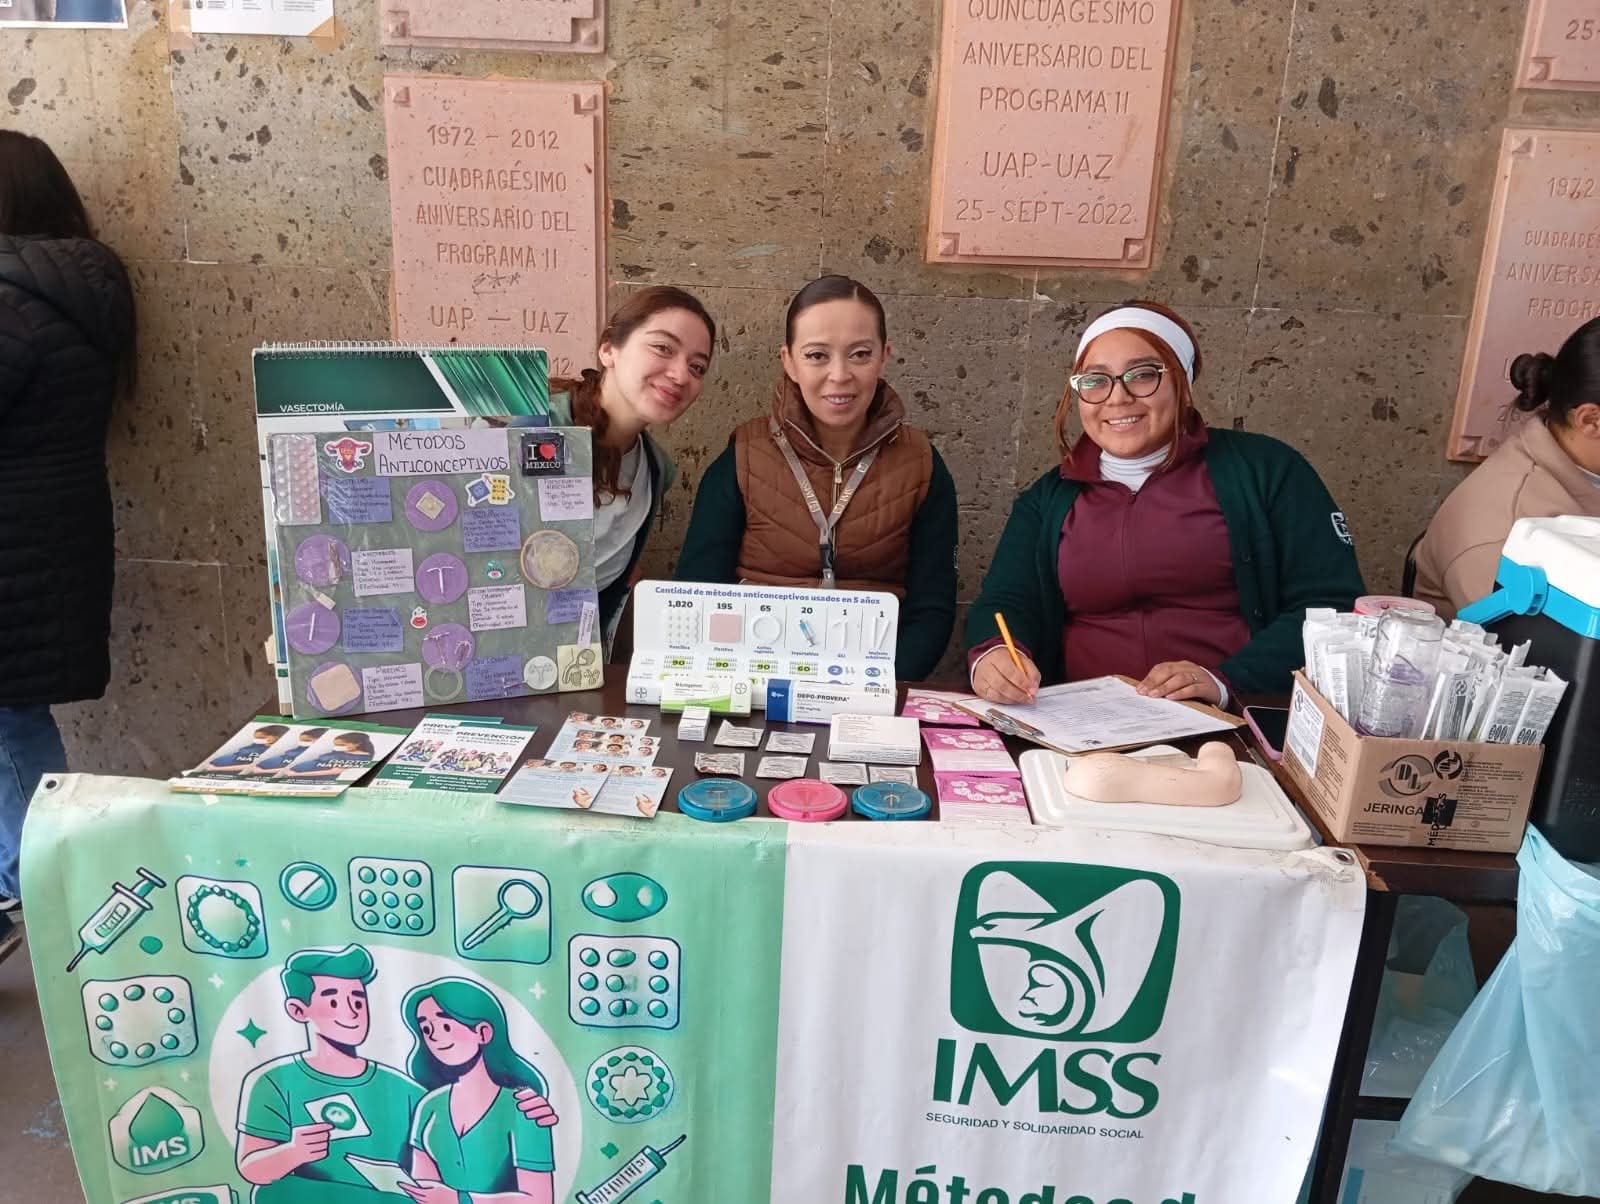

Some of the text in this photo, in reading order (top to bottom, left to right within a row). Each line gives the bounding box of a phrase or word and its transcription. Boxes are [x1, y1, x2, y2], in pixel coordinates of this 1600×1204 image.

[963, 41, 1153, 71] ANIVERSARIO DEL
[979, 86, 1107, 114] PROGRAMA
[427, 125, 475, 146] 1972
[511, 128, 560, 150] 2012
[423, 161, 567, 193] CUADRAGÉSIMO
[416, 204, 576, 232] ANIVERSARIO DEL
[437, 242, 536, 269] PROGRAMA
[431, 305, 474, 329] UAP
[523, 311, 569, 334] UAZ
[279, 404, 345, 413] VASECTOMÍA
[388, 433, 466, 450] MÉTODOS
[379, 454, 508, 473] ANTICONCEPTIVOS
[655, 587, 692, 595] Cantidad
[694, 588, 705, 596] de
[706, 589, 741, 598] métodos
[743, 591, 809, 601] anticonceptivos
[811, 593, 840, 603] usados
[860, 596, 880, 604] años
[668, 600, 693, 608] 1,820
[933, 1038, 1162, 1119] IMSS
[925, 1112, 1145, 1139] SEGURIDAD Y SOLIDARIDAD SOCIAL
[132, 1136, 188, 1167] IMS
